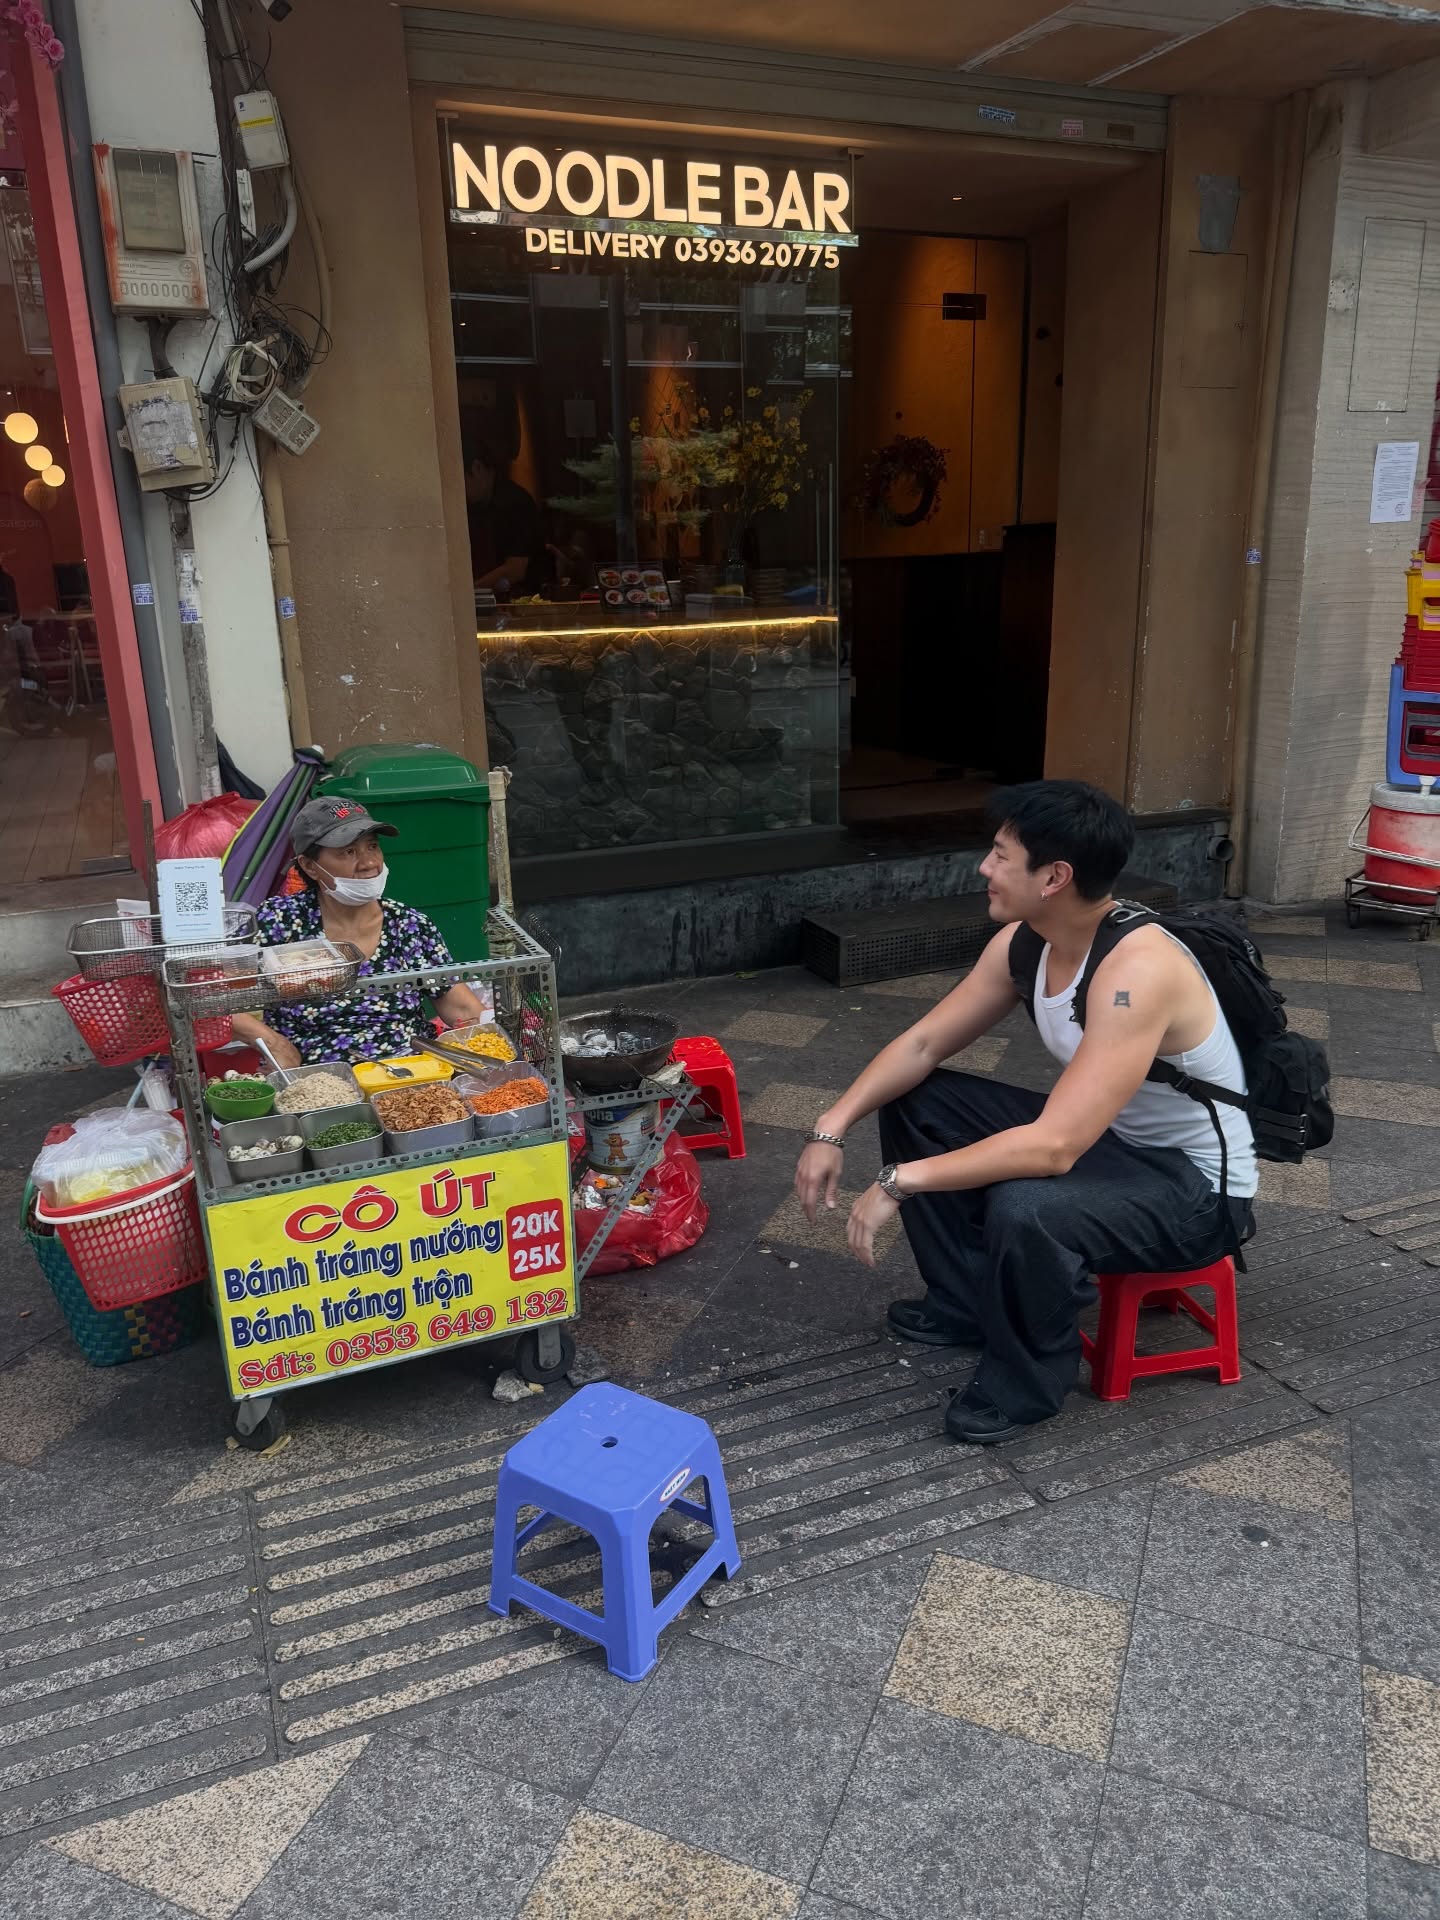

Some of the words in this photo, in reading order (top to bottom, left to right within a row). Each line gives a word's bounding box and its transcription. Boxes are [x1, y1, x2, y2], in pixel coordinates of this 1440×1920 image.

[453, 142, 722, 225] NOODLE
[733, 165, 850, 233] BAR
[525, 227, 666, 259] DELIVERY
[284, 1185, 398, 1243] CÔ
[419, 1168, 496, 1218] ÚT
[511, 1209, 560, 1240] 20K
[223, 1257, 309, 1303] Bánh
[315, 1238, 403, 1282] tráng
[409, 1217, 504, 1262] nướng
[513, 1242, 562, 1274] 25K
[229, 1302, 315, 1349] Bánh
[320, 1286, 406, 1329] tráng
[411, 1268, 473, 1310] trộn
[239, 1351, 318, 1389] Sđt:
[325, 1322, 419, 1367] 0353
[427, 1304, 496, 1343] 649
[506, 1287, 569, 1325] 132
